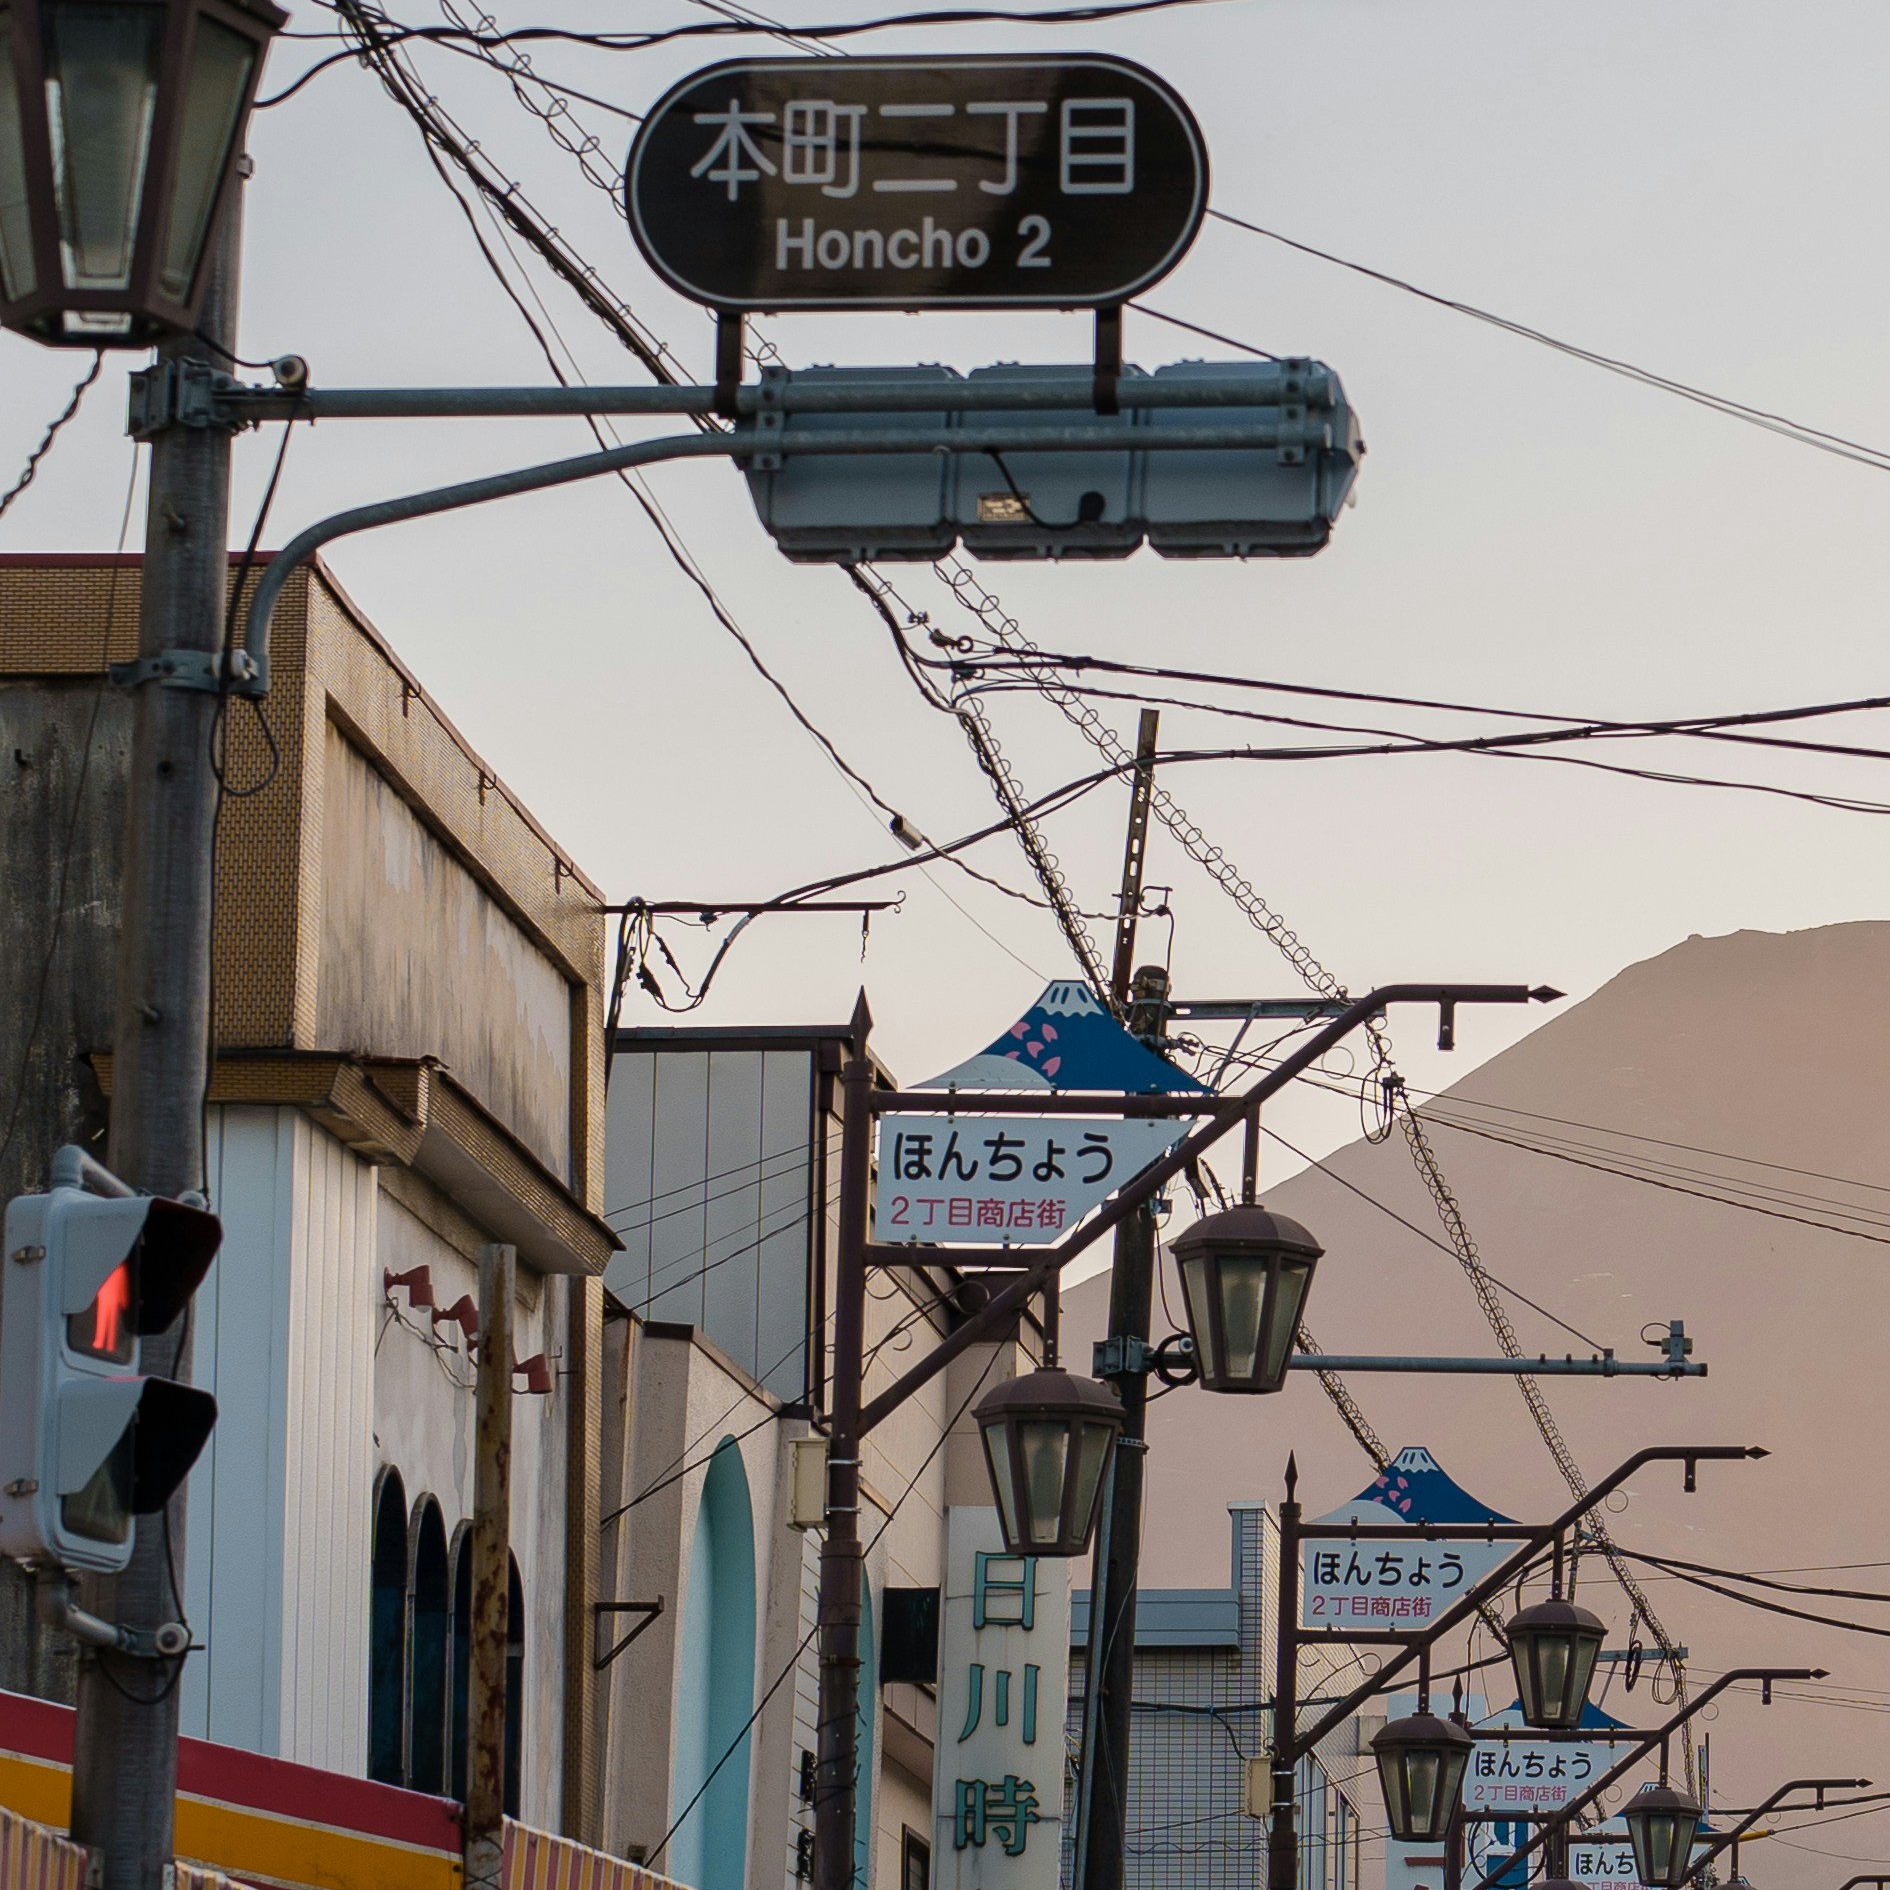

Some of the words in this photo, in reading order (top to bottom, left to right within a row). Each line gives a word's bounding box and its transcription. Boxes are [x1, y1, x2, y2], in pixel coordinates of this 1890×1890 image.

[691, 98, 1136, 202] 本町二丁目
[775, 216, 991, 271] Honcho
[1017, 215, 1052, 269] 2
[893, 1131, 1114, 1184] ほんちょう
[890, 1196, 1067, 1230] 2丁目商店街
[1312, 1551, 1465, 1588] ほんちょう
[1312, 1595, 1433, 1618] 2丁目商店街
[1475, 1750, 1593, 1779] ほんちょう
[1474, 1785, 1567, 1803] 2丁目商店街
[1575, 1851, 1636, 1875] ほんち
